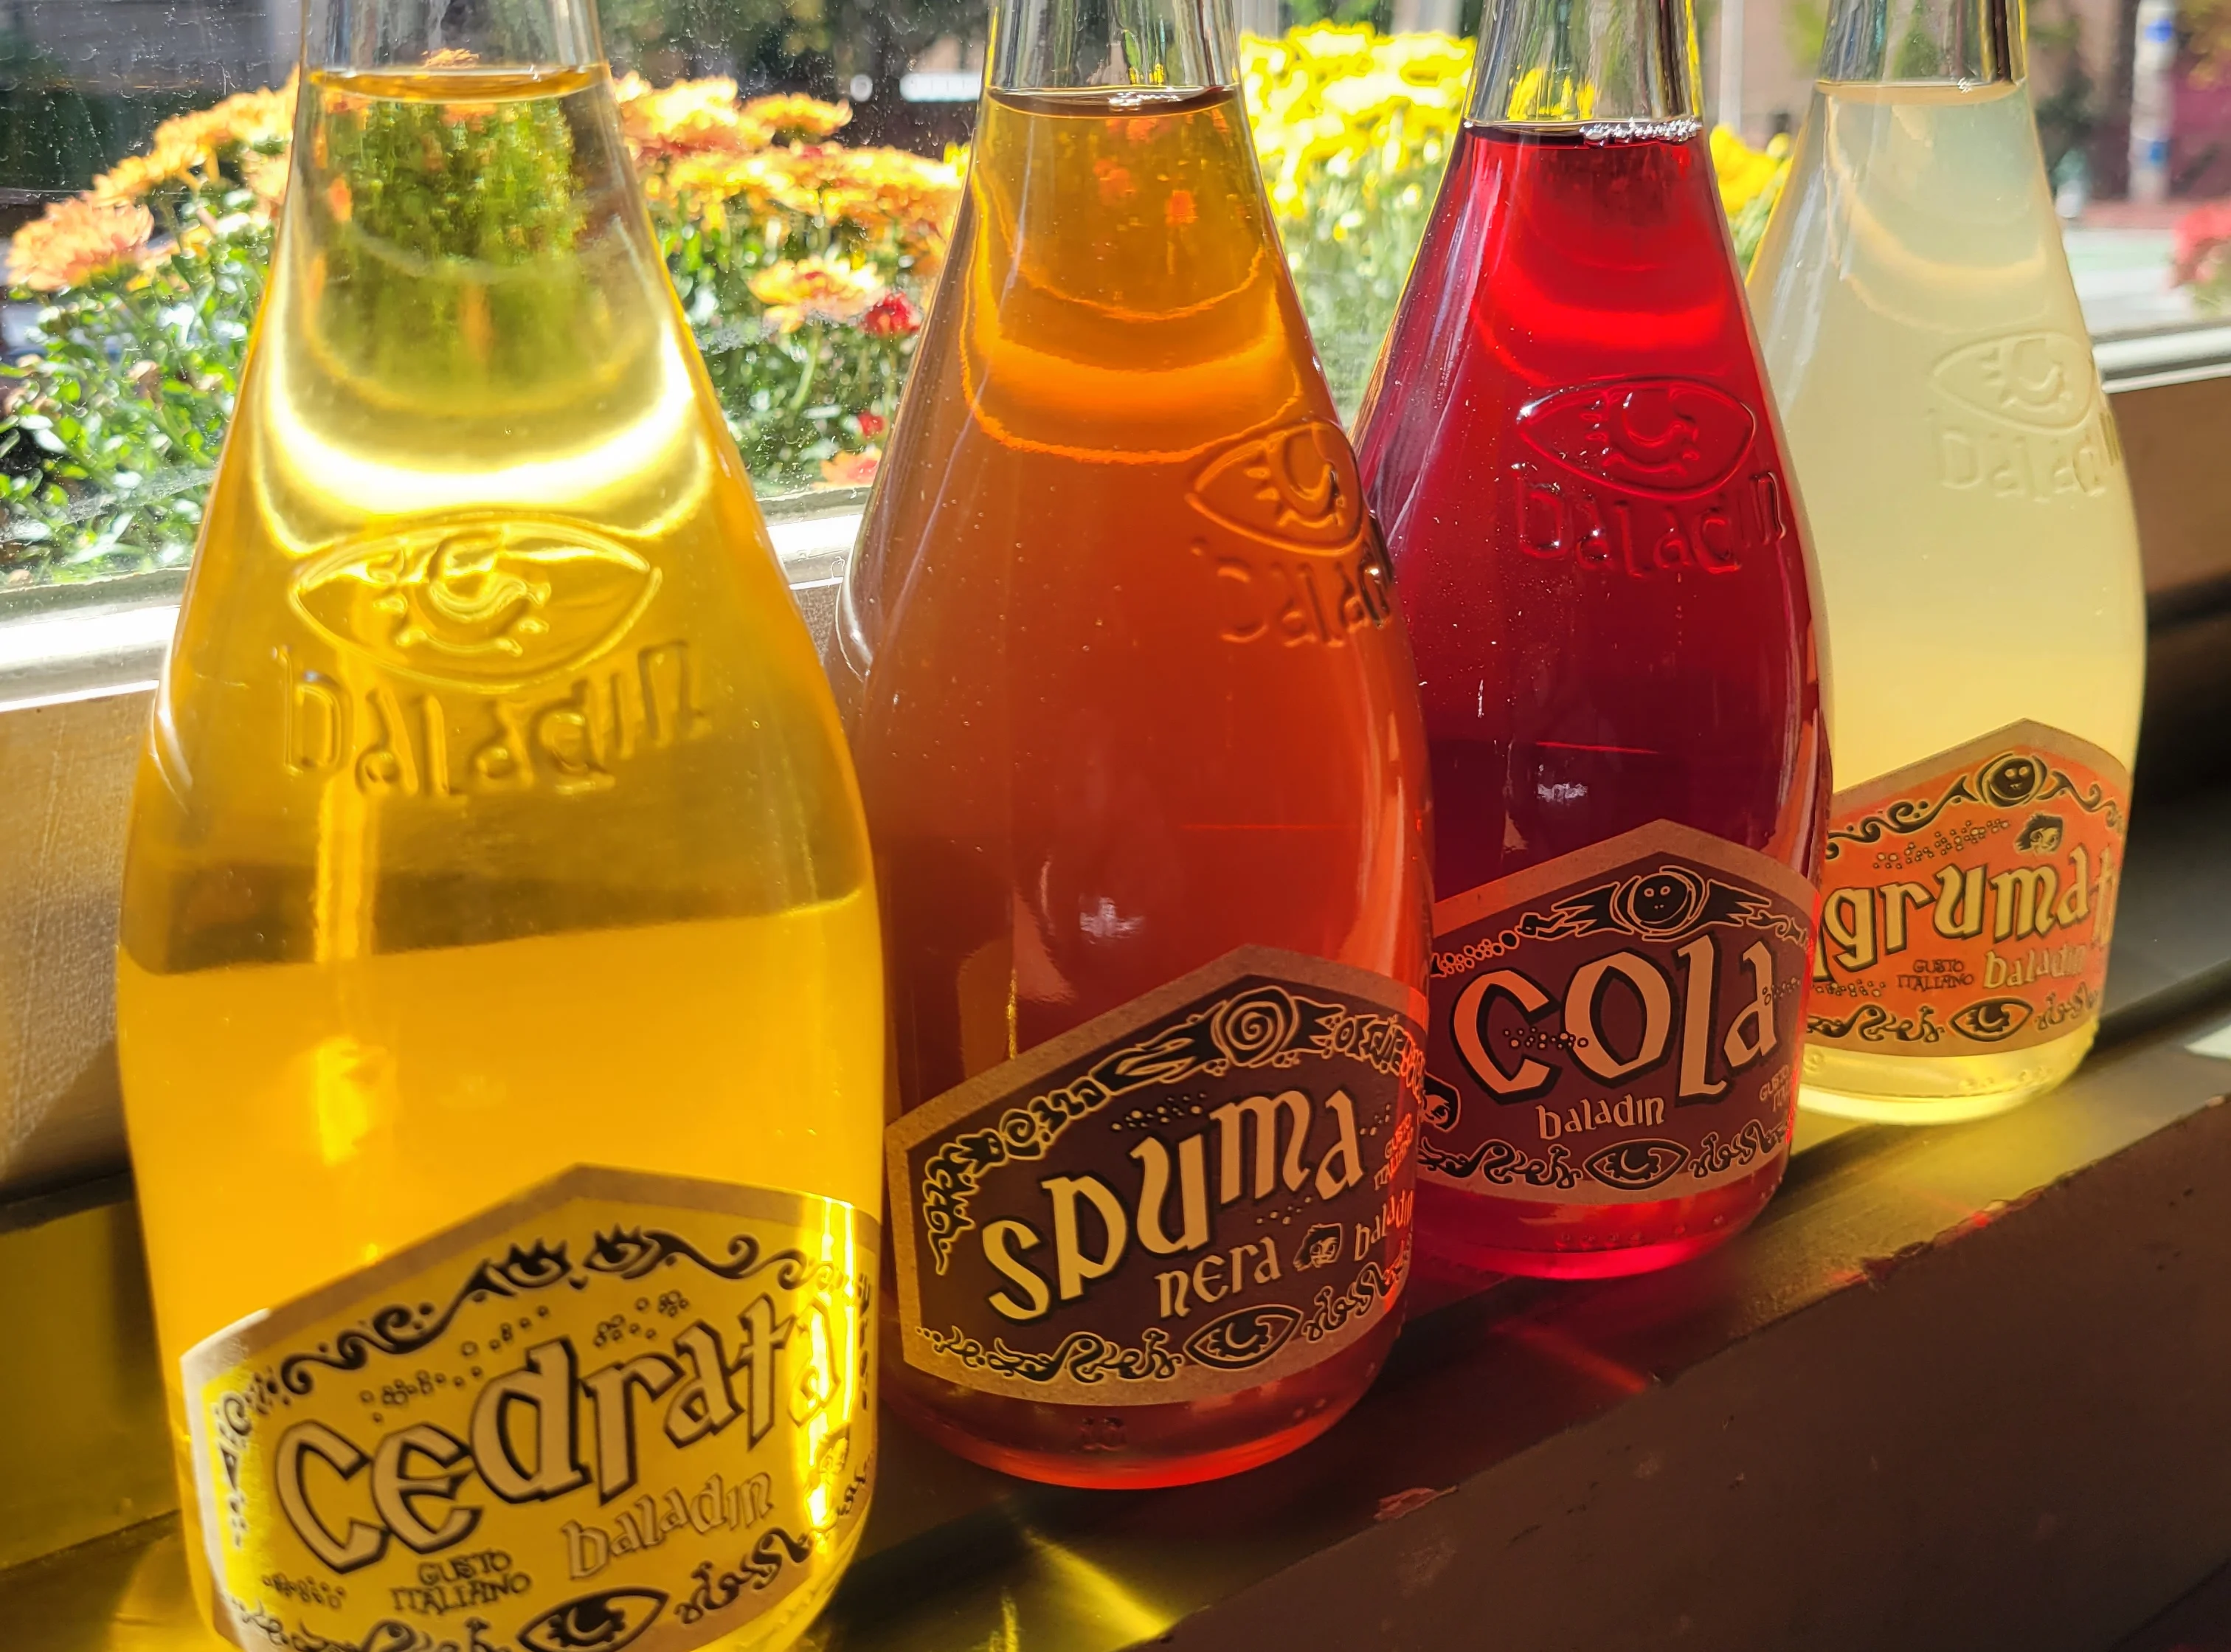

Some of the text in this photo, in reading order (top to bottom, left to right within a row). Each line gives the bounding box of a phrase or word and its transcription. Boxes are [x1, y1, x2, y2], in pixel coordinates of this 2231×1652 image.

[1896, 972, 1974, 992] ITALIANO
[1912, 958, 1965, 974] GUSTO
[1537, 1093, 1665, 1141] baladin
[1155, 1234, 1281, 1319] nera
[558, 1470, 774, 1581] baladin
[417, 1547, 513, 1586] GUSTO
[390, 1570, 533, 1617] ITALIANO
